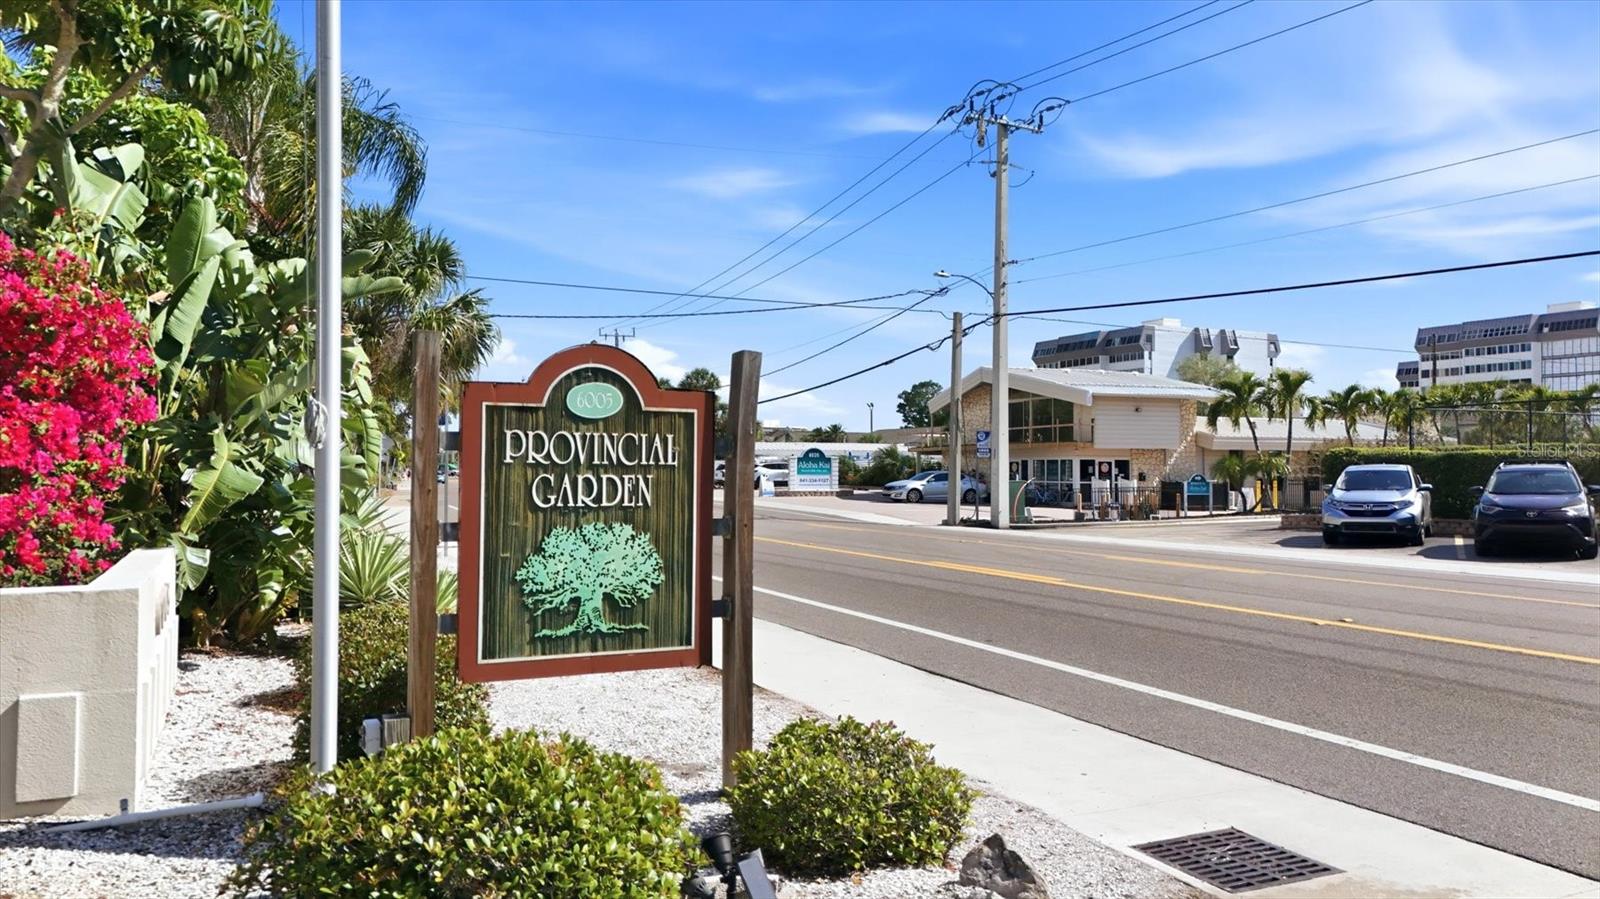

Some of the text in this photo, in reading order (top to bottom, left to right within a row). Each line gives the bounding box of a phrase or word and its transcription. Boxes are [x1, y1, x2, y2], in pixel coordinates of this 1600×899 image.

[577, 392, 613, 409] 6005
[504, 429, 678, 467] PROVINCIAL
[532, 473, 654, 508] GARDEN
